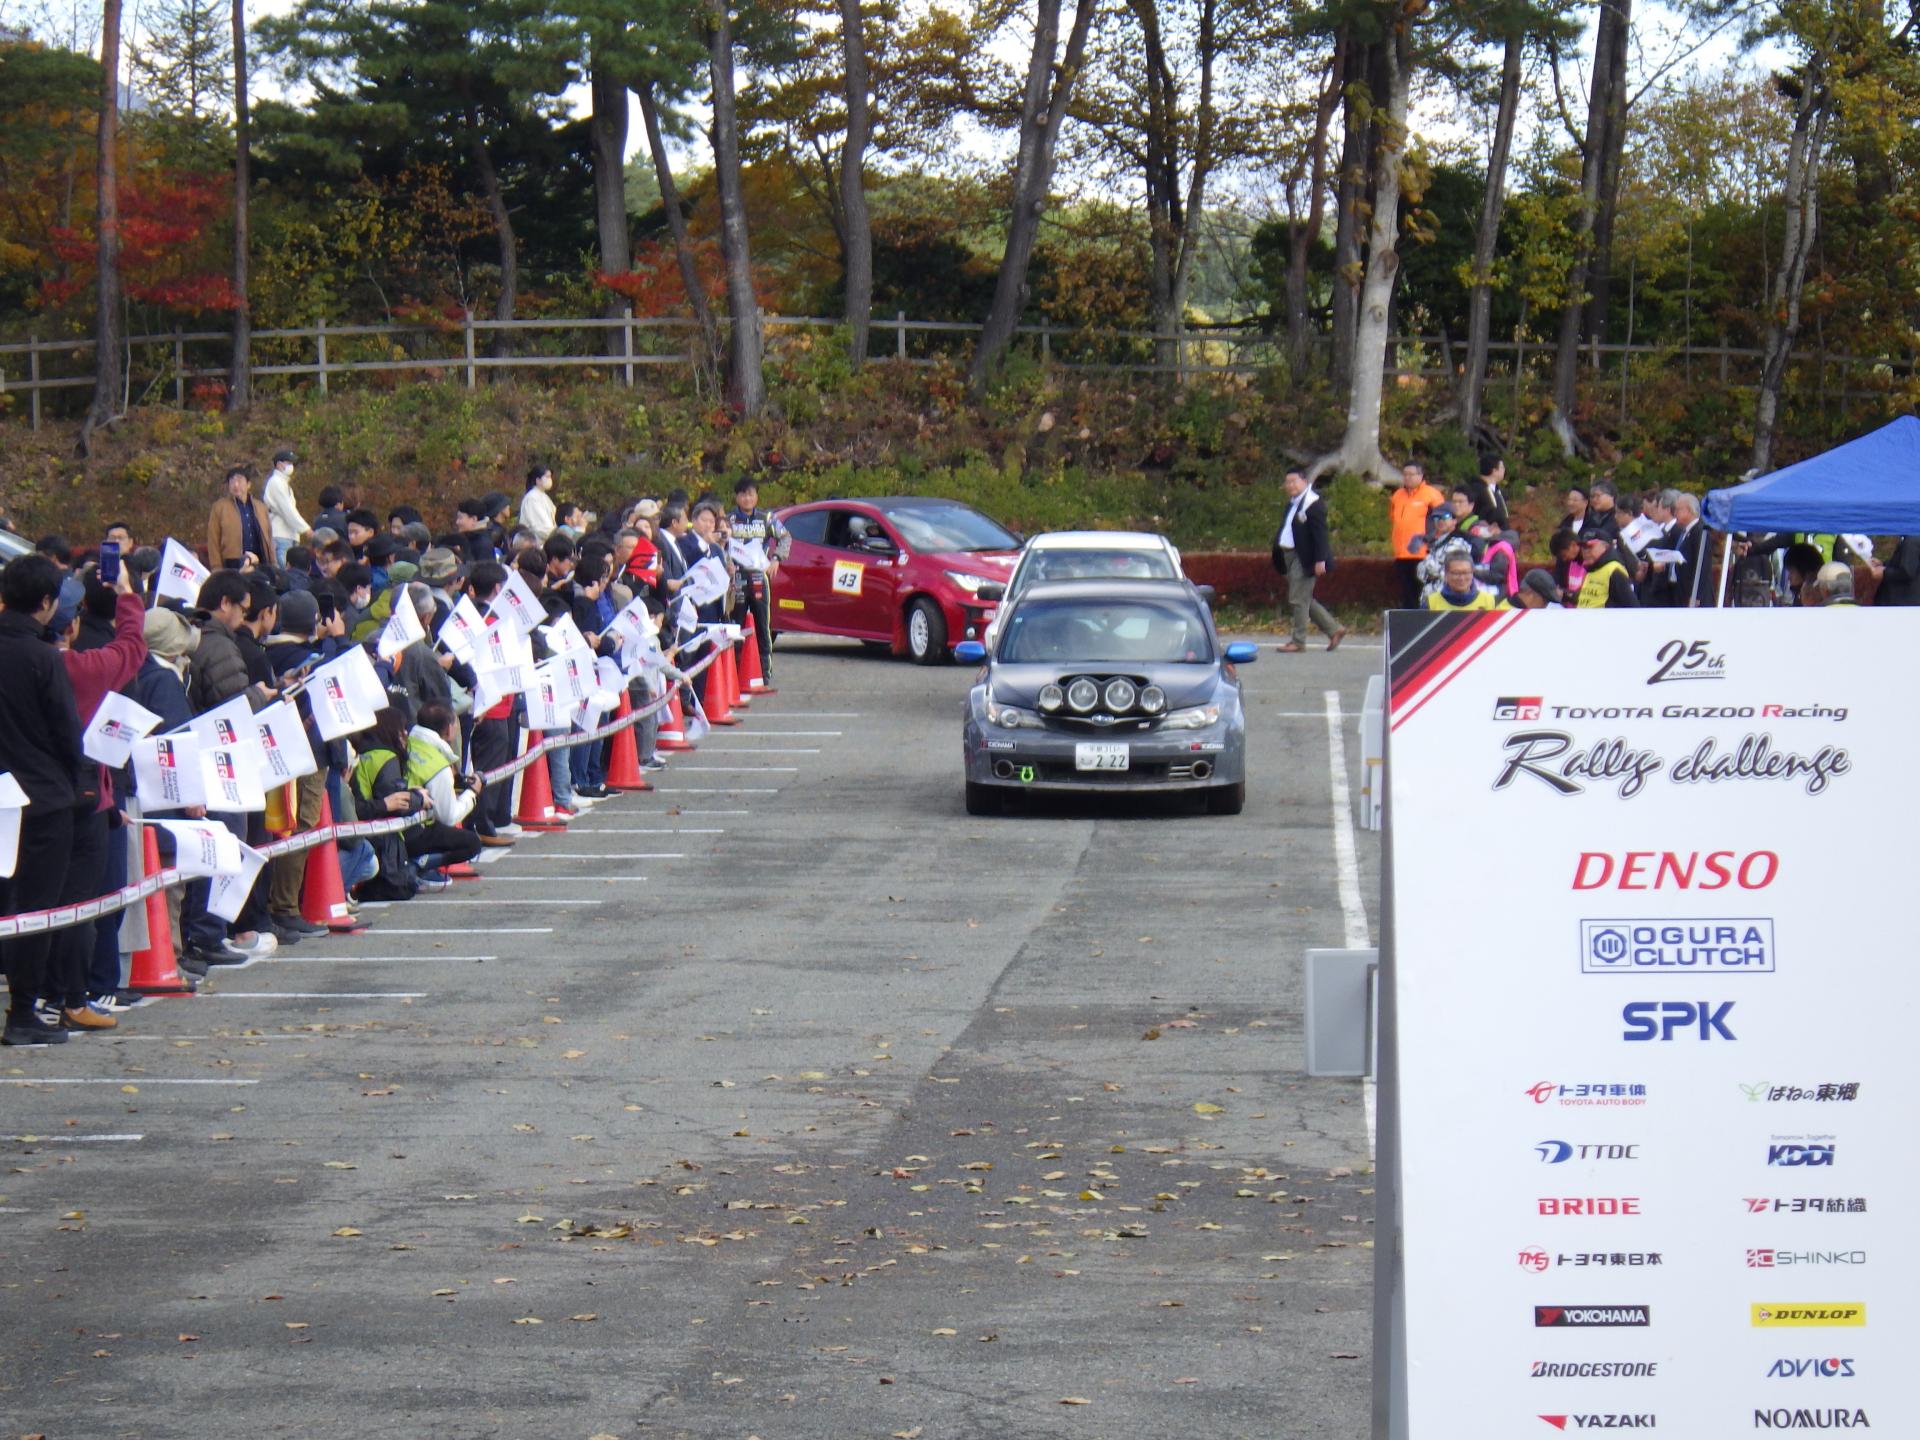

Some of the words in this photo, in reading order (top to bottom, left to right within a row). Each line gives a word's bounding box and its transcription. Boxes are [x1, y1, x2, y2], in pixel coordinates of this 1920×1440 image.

[838, 573, 857, 588] 43
[1647, 640, 1725, 684] 25th
[1669, 669, 1726, 677] ANNIVERSARY
[1494, 703, 1543, 721] GR
[1552, 705, 1653, 718] TOYOTA
[1662, 705, 1755, 718] GAZOO
[1762, 704, 1849, 721] Racing
[215, 719, 233, 745] GR
[157, 739, 172, 768] GR
[215, 751, 230, 778] GR
[1492, 730, 1663, 799] Rally
[1671, 733, 1852, 797] challenge
[1572, 851, 1779, 890] DENSO
[1633, 927, 1763, 945] OGURA
[1633, 948, 1765, 965] CLUTCH
[1623, 1001, 1737, 1041] SPK
[1558, 1084, 1647, 1096] トヨタ車体
[1768, 1082, 1861, 1102] ばねの東郷
[1559, 1098, 1593, 1106] TOYOTA
[1596, 1098, 1620, 1106] AUTO
[1622, 1098, 1647, 1106] BODY
[1578, 1144, 1640, 1160] TTDC
[1768, 1144, 1836, 1166] KDDI
[1538, 1197, 1641, 1215] BRIDE
[1774, 1198, 1867, 1213] トヨタ紡織
[1557, 1252, 1663, 1266] トヨタ東日本
[1777, 1250, 1866, 1264] SHINKO
[1564, 1308, 1646, 1323] YOKOHAMA
[1775, 1309, 1858, 1320] DUNLOP
[1531, 1361, 1658, 1378] BRIDGESTONE
[1767, 1358, 1856, 1378] ADVICS
[1573, 1414, 1656, 1428] YAZAKI
[1755, 1408, 1871, 1429] NOMURA
